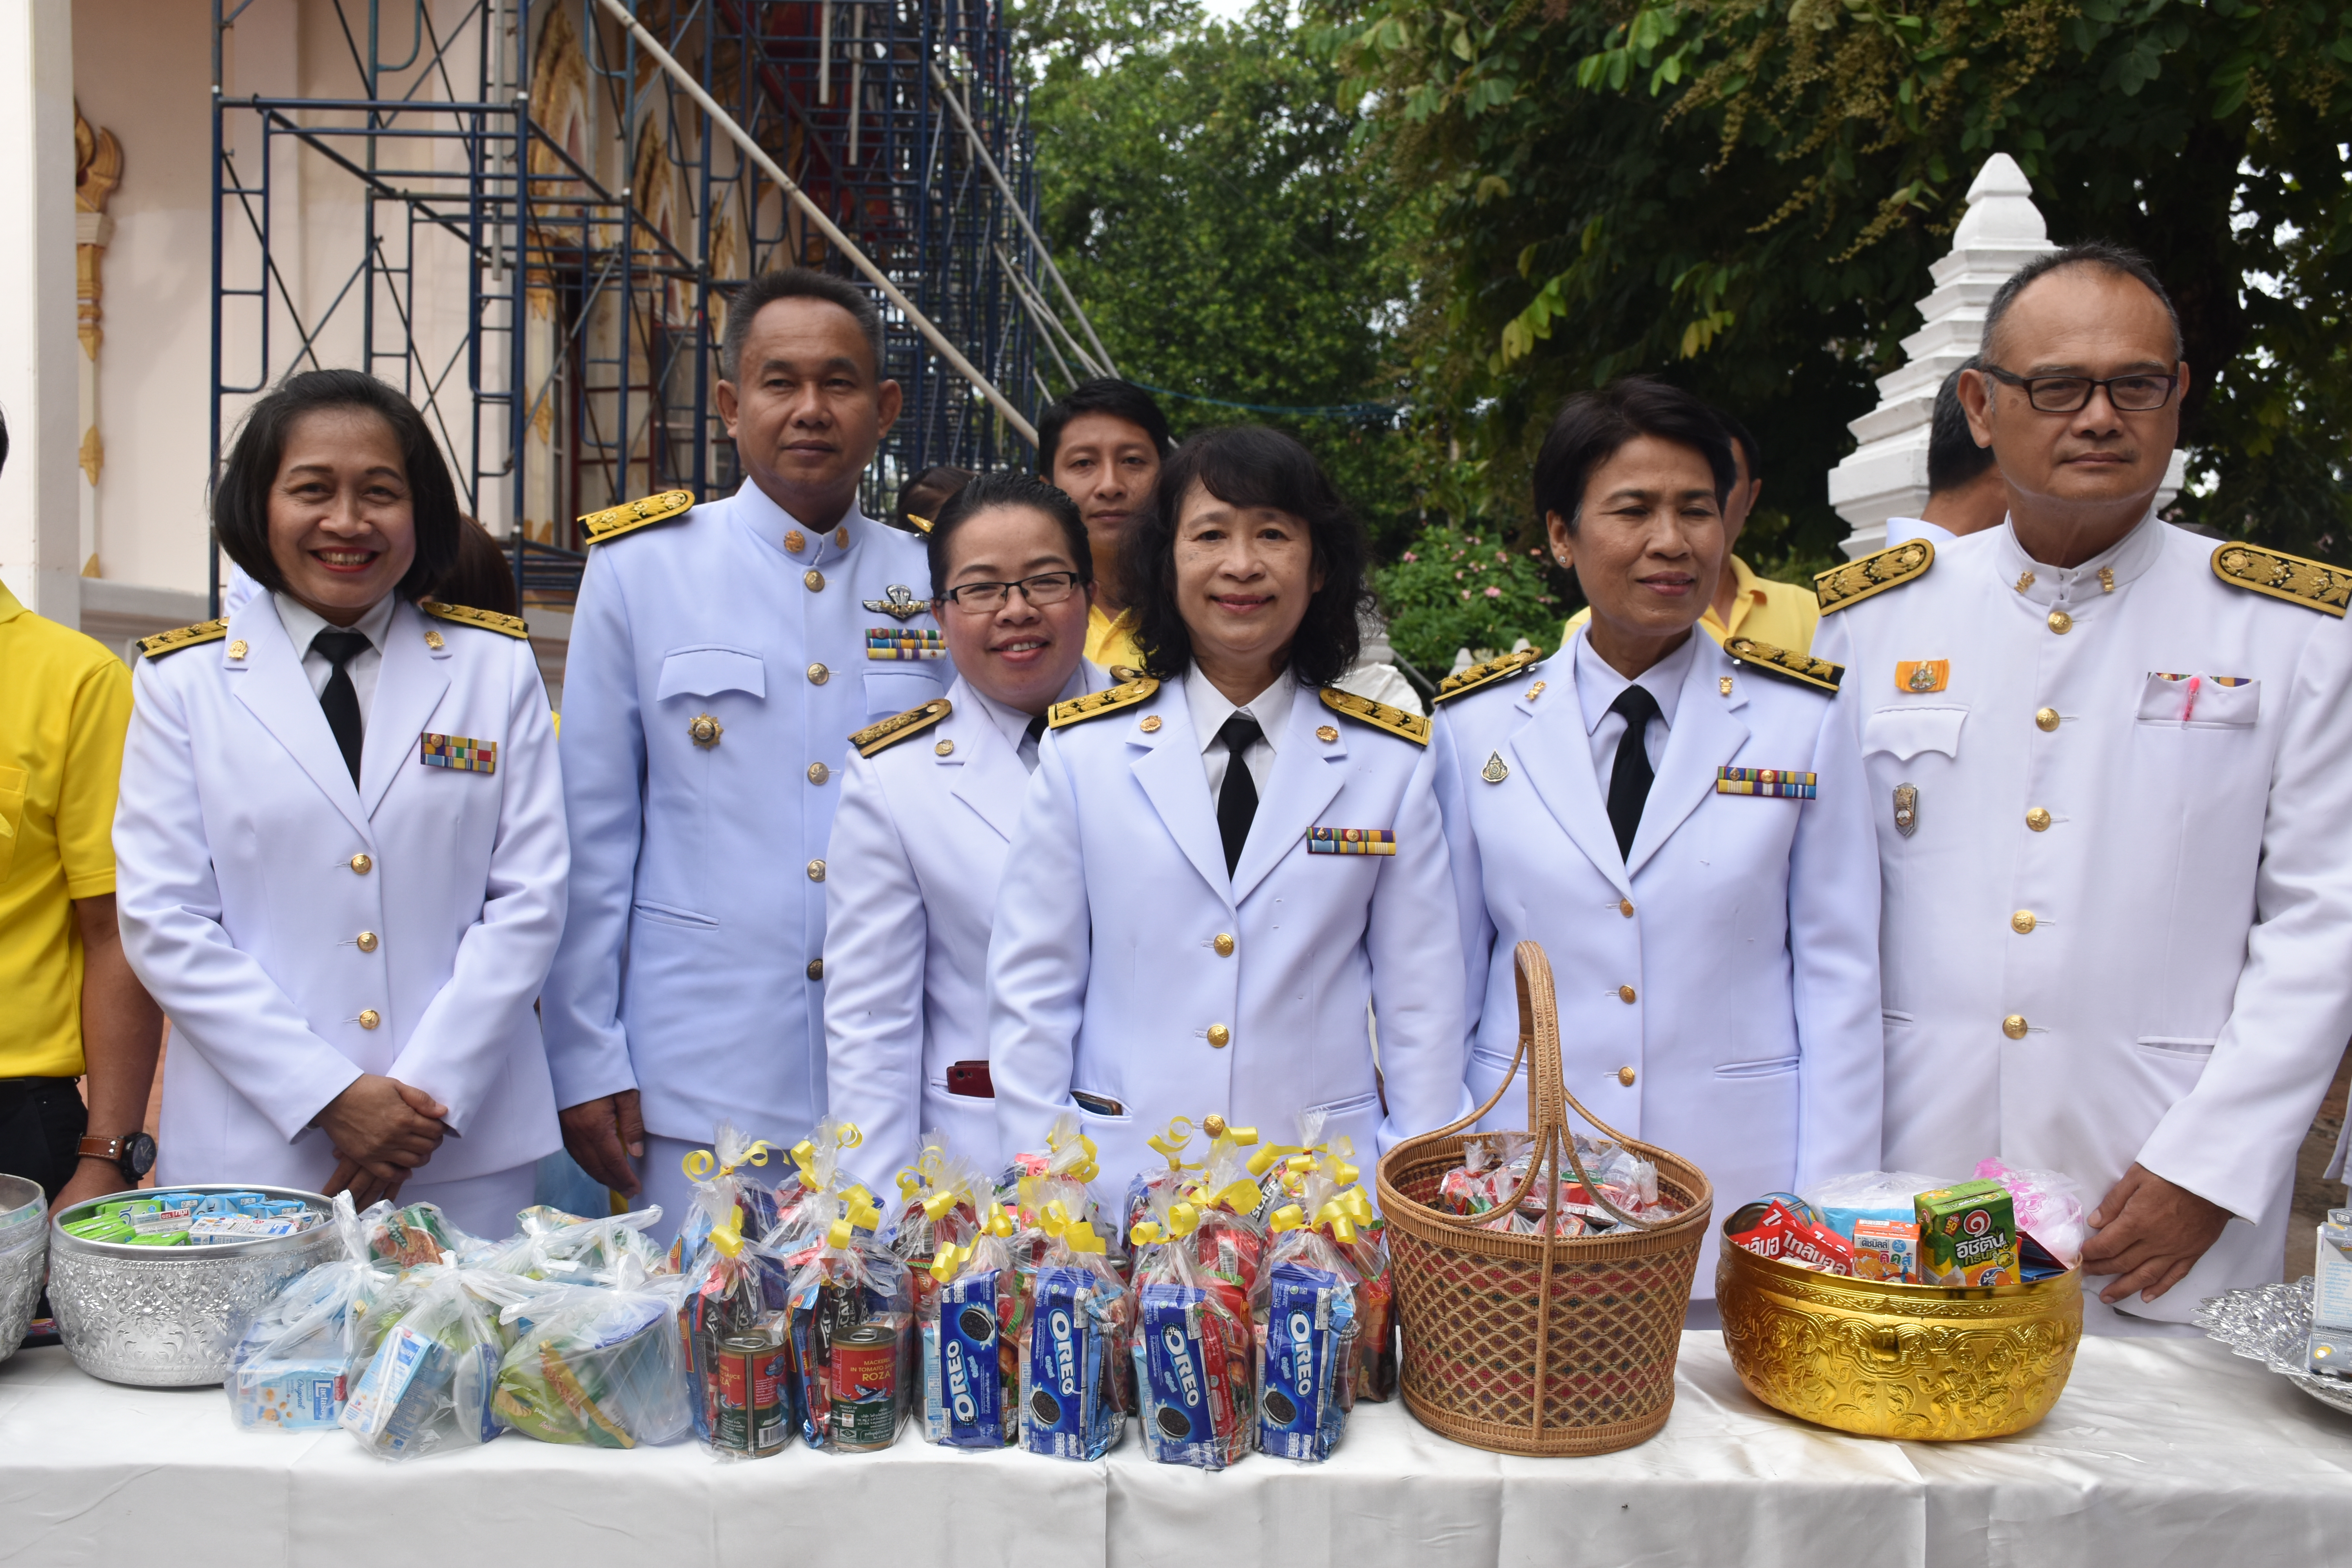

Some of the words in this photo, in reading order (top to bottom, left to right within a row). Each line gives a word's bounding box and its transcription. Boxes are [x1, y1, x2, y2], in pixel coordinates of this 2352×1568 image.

[1945, 1220, 1957, 1231] 50
[1861, 1237, 1889, 1249] ดัชมิลล์
[1956, 1232, 2004, 1259] อิชิตัน
[1880, 1250, 1912, 1267] คิดส์
[864, 1357, 891, 1366] MACKEREL
[1051, 1311, 1074, 1395] OREO
[1289, 1312, 1312, 1396] OREO
[862, 1370, 891, 1381] ROZA
[968, 1356, 978, 1377] Original
[1045, 1356, 1055, 1378] Original
[1163, 1324, 1200, 1407] OREO
[1281, 1357, 1291, 1379] Original
[947, 1340, 976, 1423] OREO
[1164, 1372, 1178, 1393] Original
[294, 1379, 306, 1409] Original
